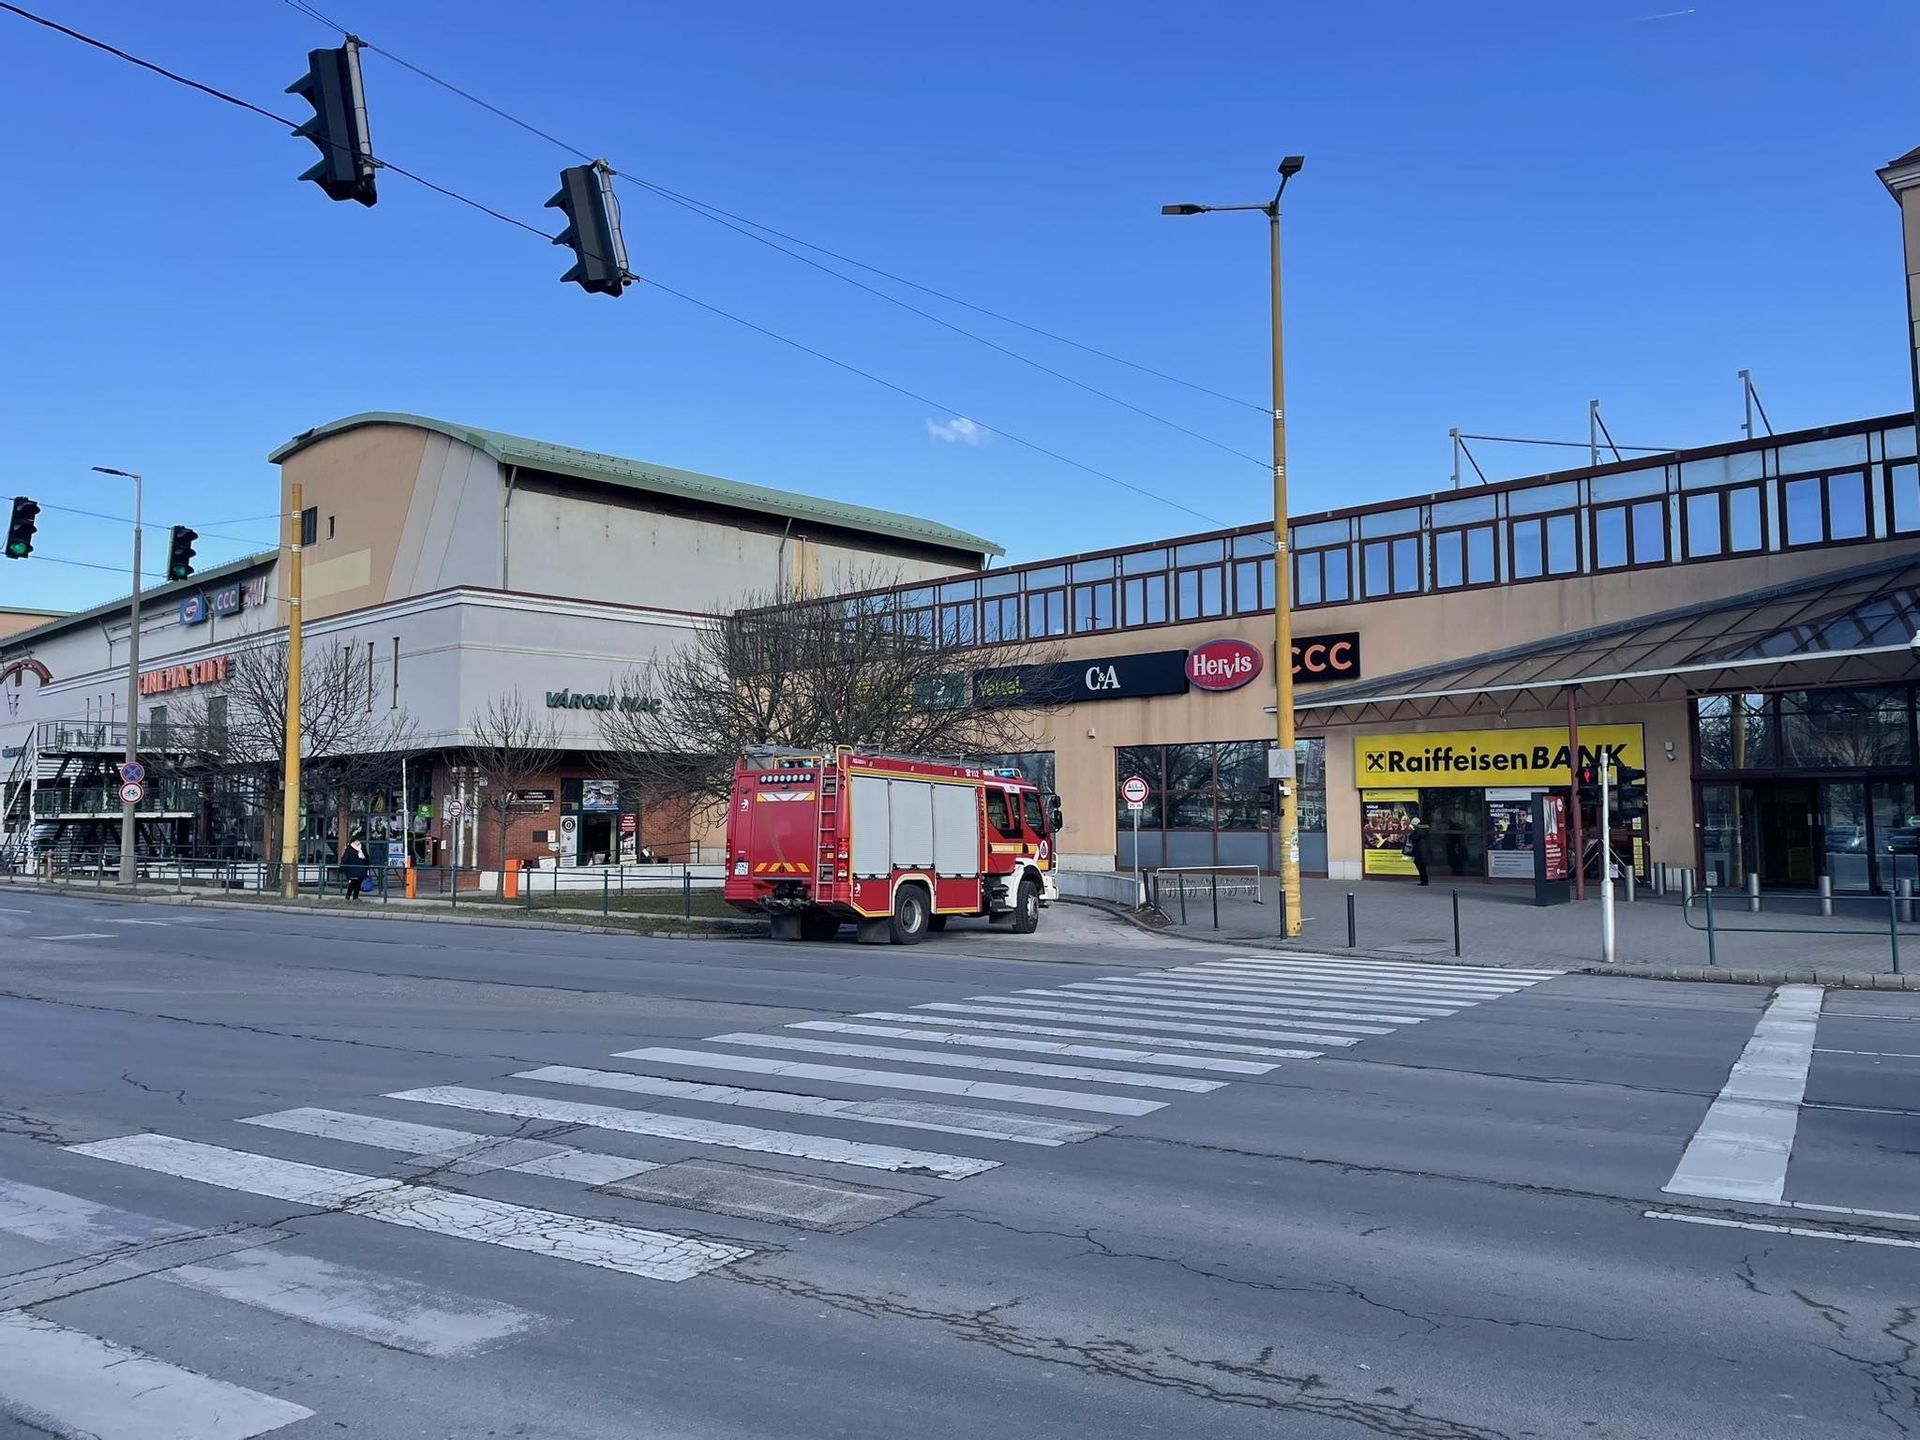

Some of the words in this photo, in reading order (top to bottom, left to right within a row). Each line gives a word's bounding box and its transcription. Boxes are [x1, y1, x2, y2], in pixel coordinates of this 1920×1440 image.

[217, 590, 236, 610] CCC
[1085, 664, 1120, 690] C&A
[1193, 652, 1253, 679] Hervis
[545, 687, 615, 711] VÁROSI
